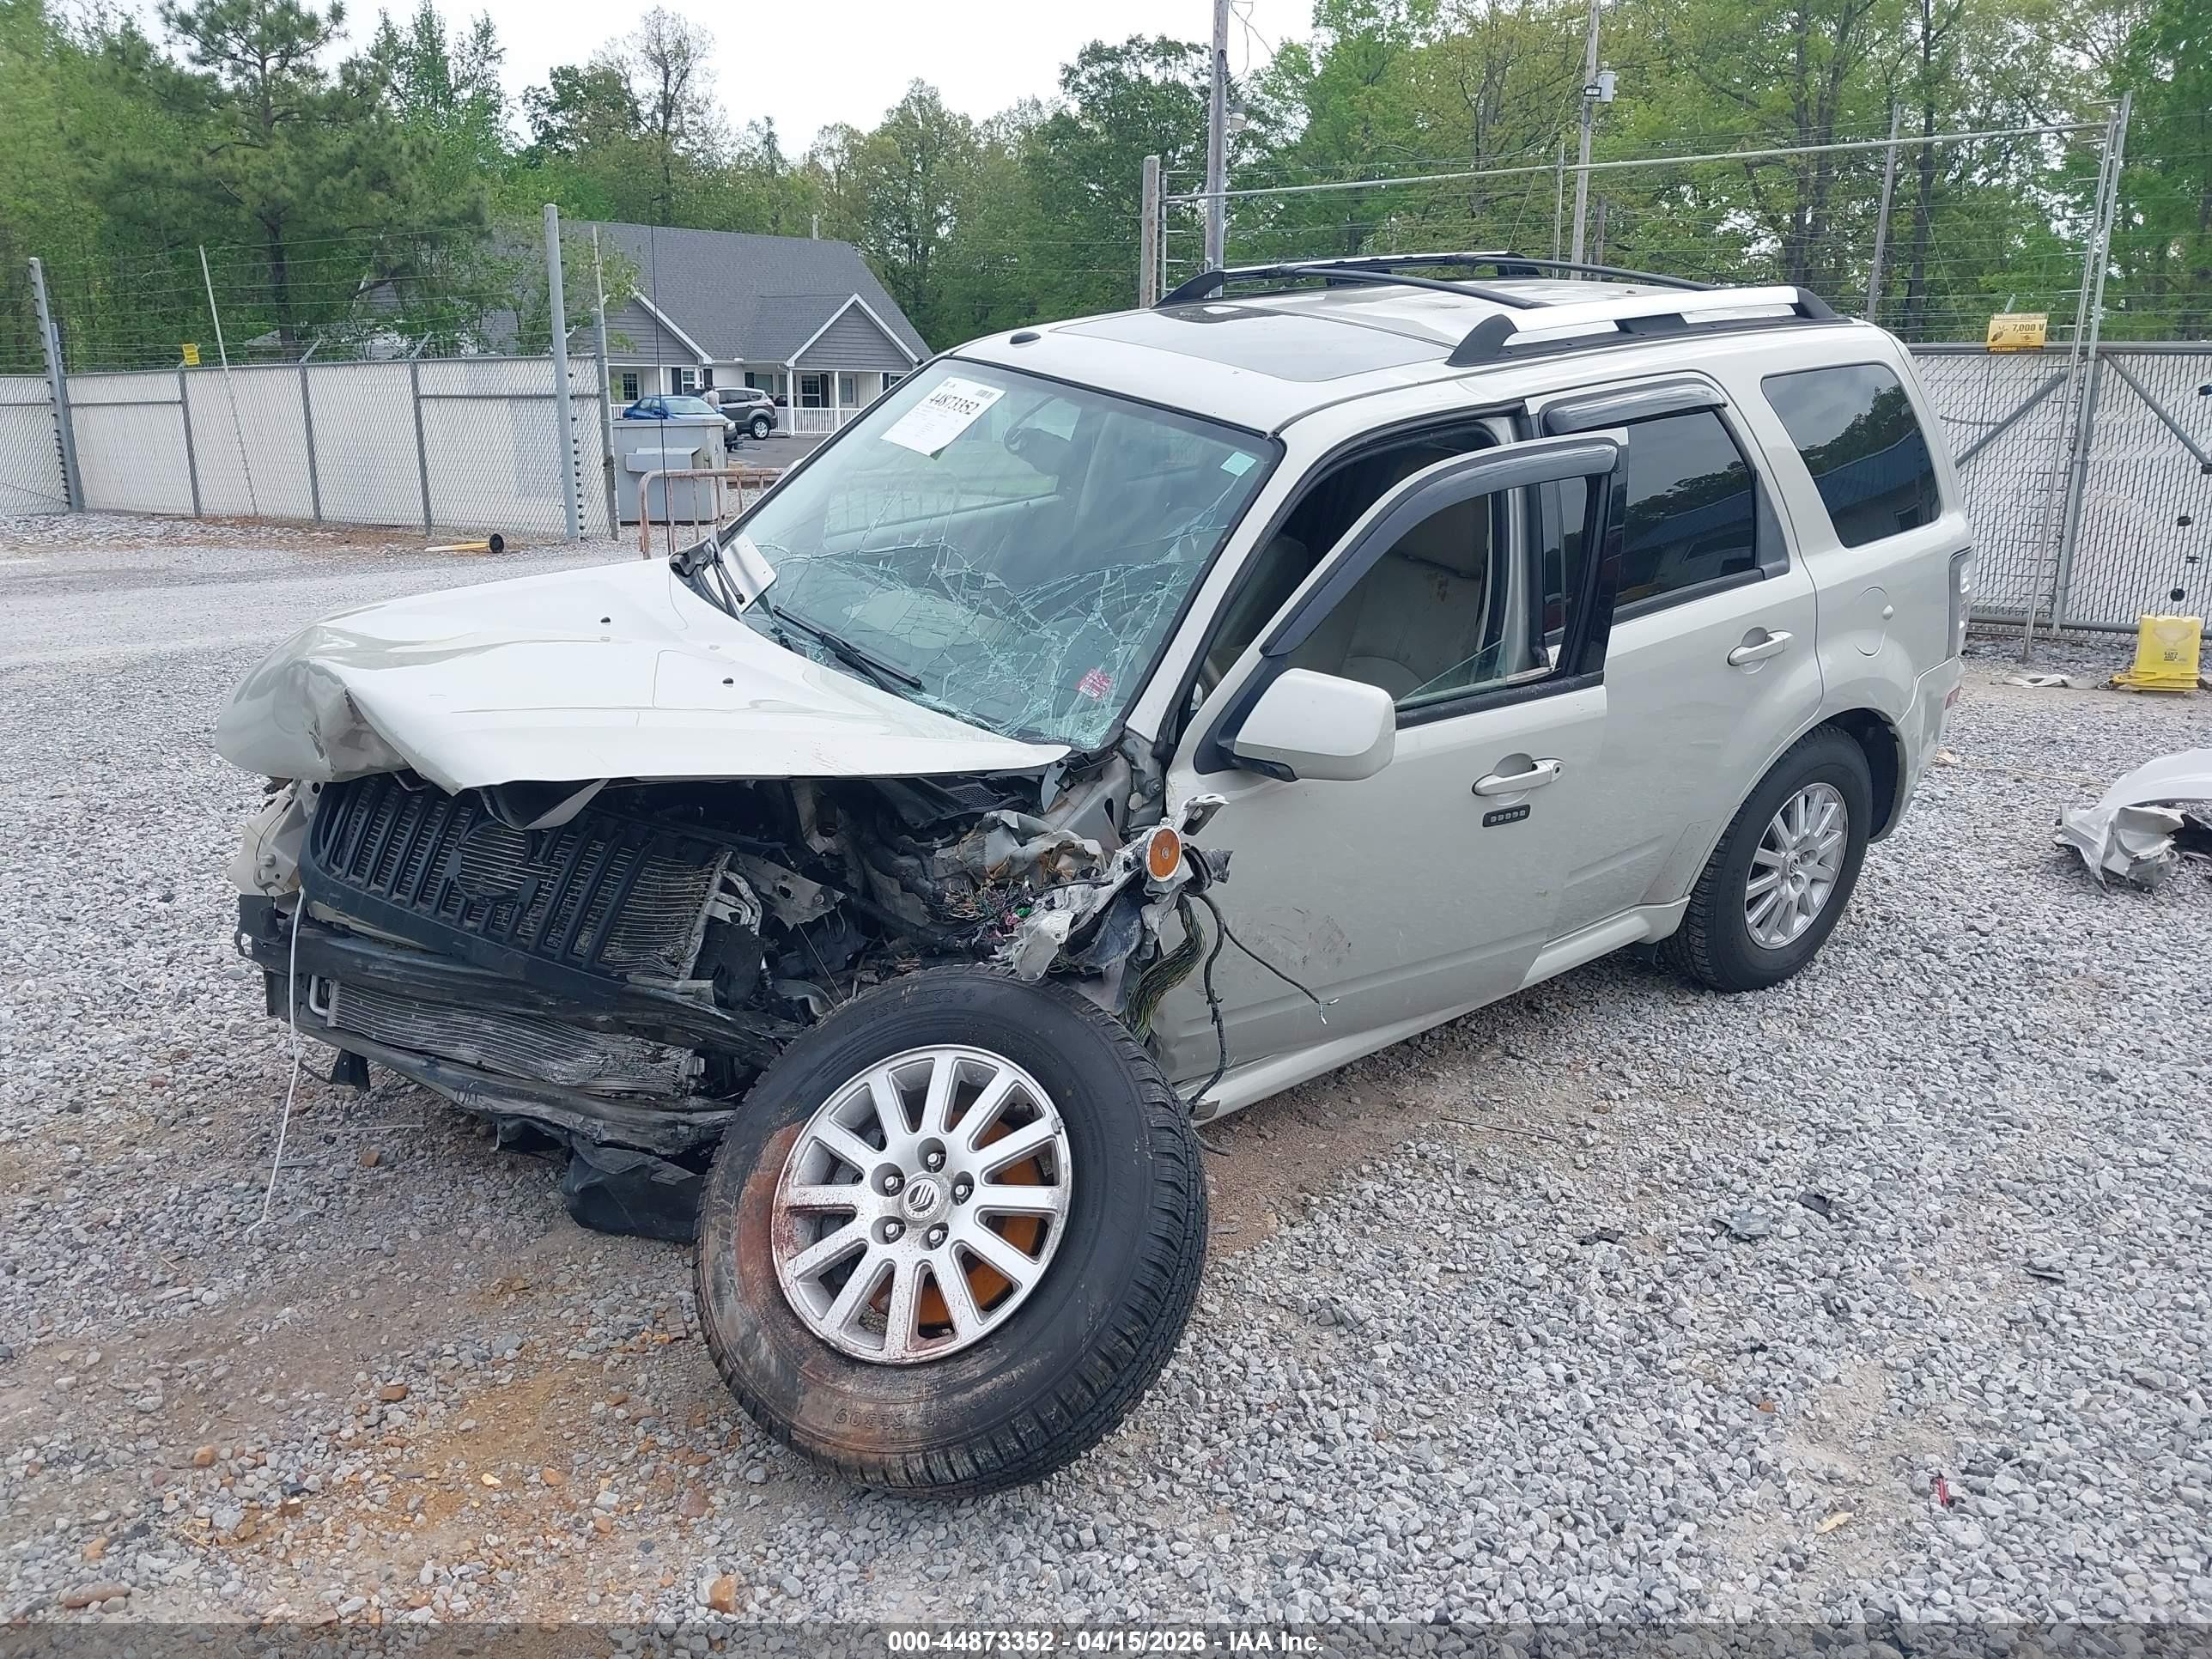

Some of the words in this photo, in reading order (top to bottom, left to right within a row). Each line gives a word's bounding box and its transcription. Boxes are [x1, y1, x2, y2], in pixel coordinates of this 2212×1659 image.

[2012, 323, 2036, 333] 7,000
[2039, 323, 2045, 331] V
[929, 392, 980, 416] 44873352
[835, 1407, 906, 1430] SL309
